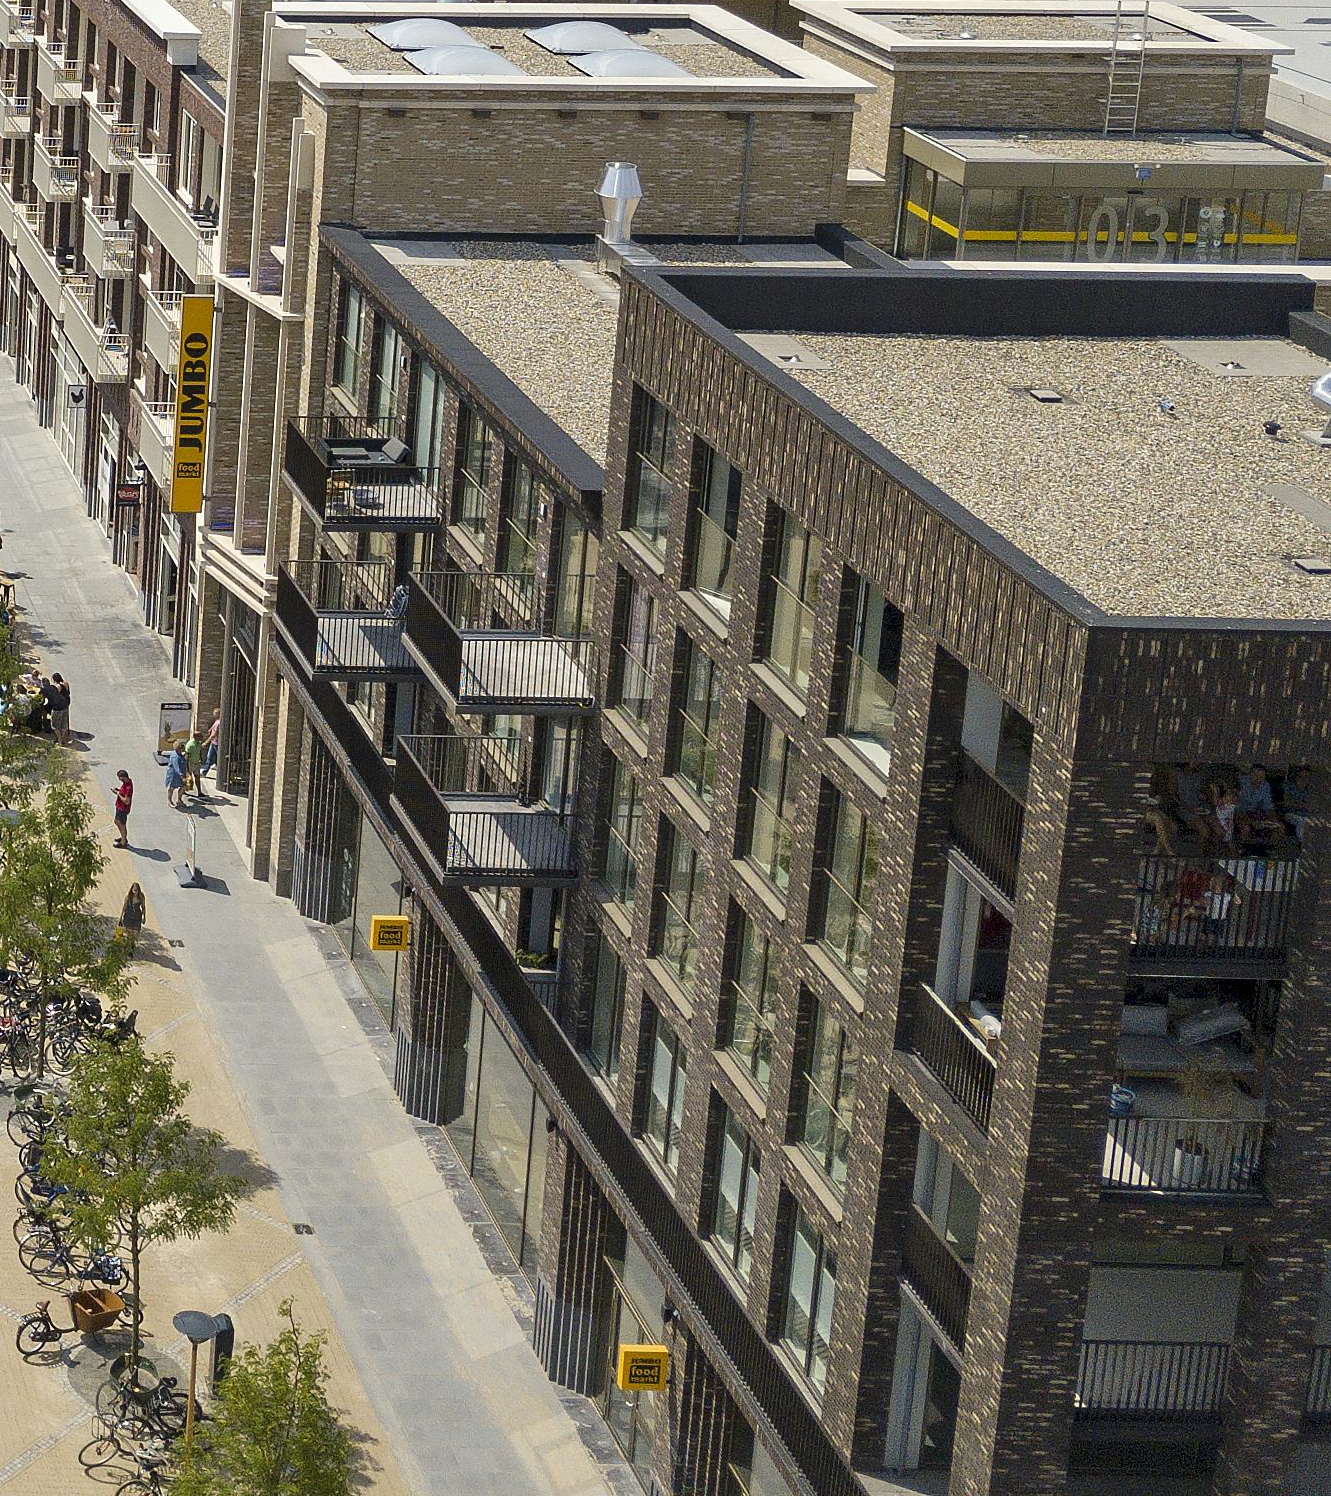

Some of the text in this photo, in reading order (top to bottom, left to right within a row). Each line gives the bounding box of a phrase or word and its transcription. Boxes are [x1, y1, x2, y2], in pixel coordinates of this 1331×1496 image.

[179, 332, 209, 453] JUMBO
[178, 463, 200, 471] food
[380, 931, 401, 939] food
[631, 1366, 659, 1376] food
